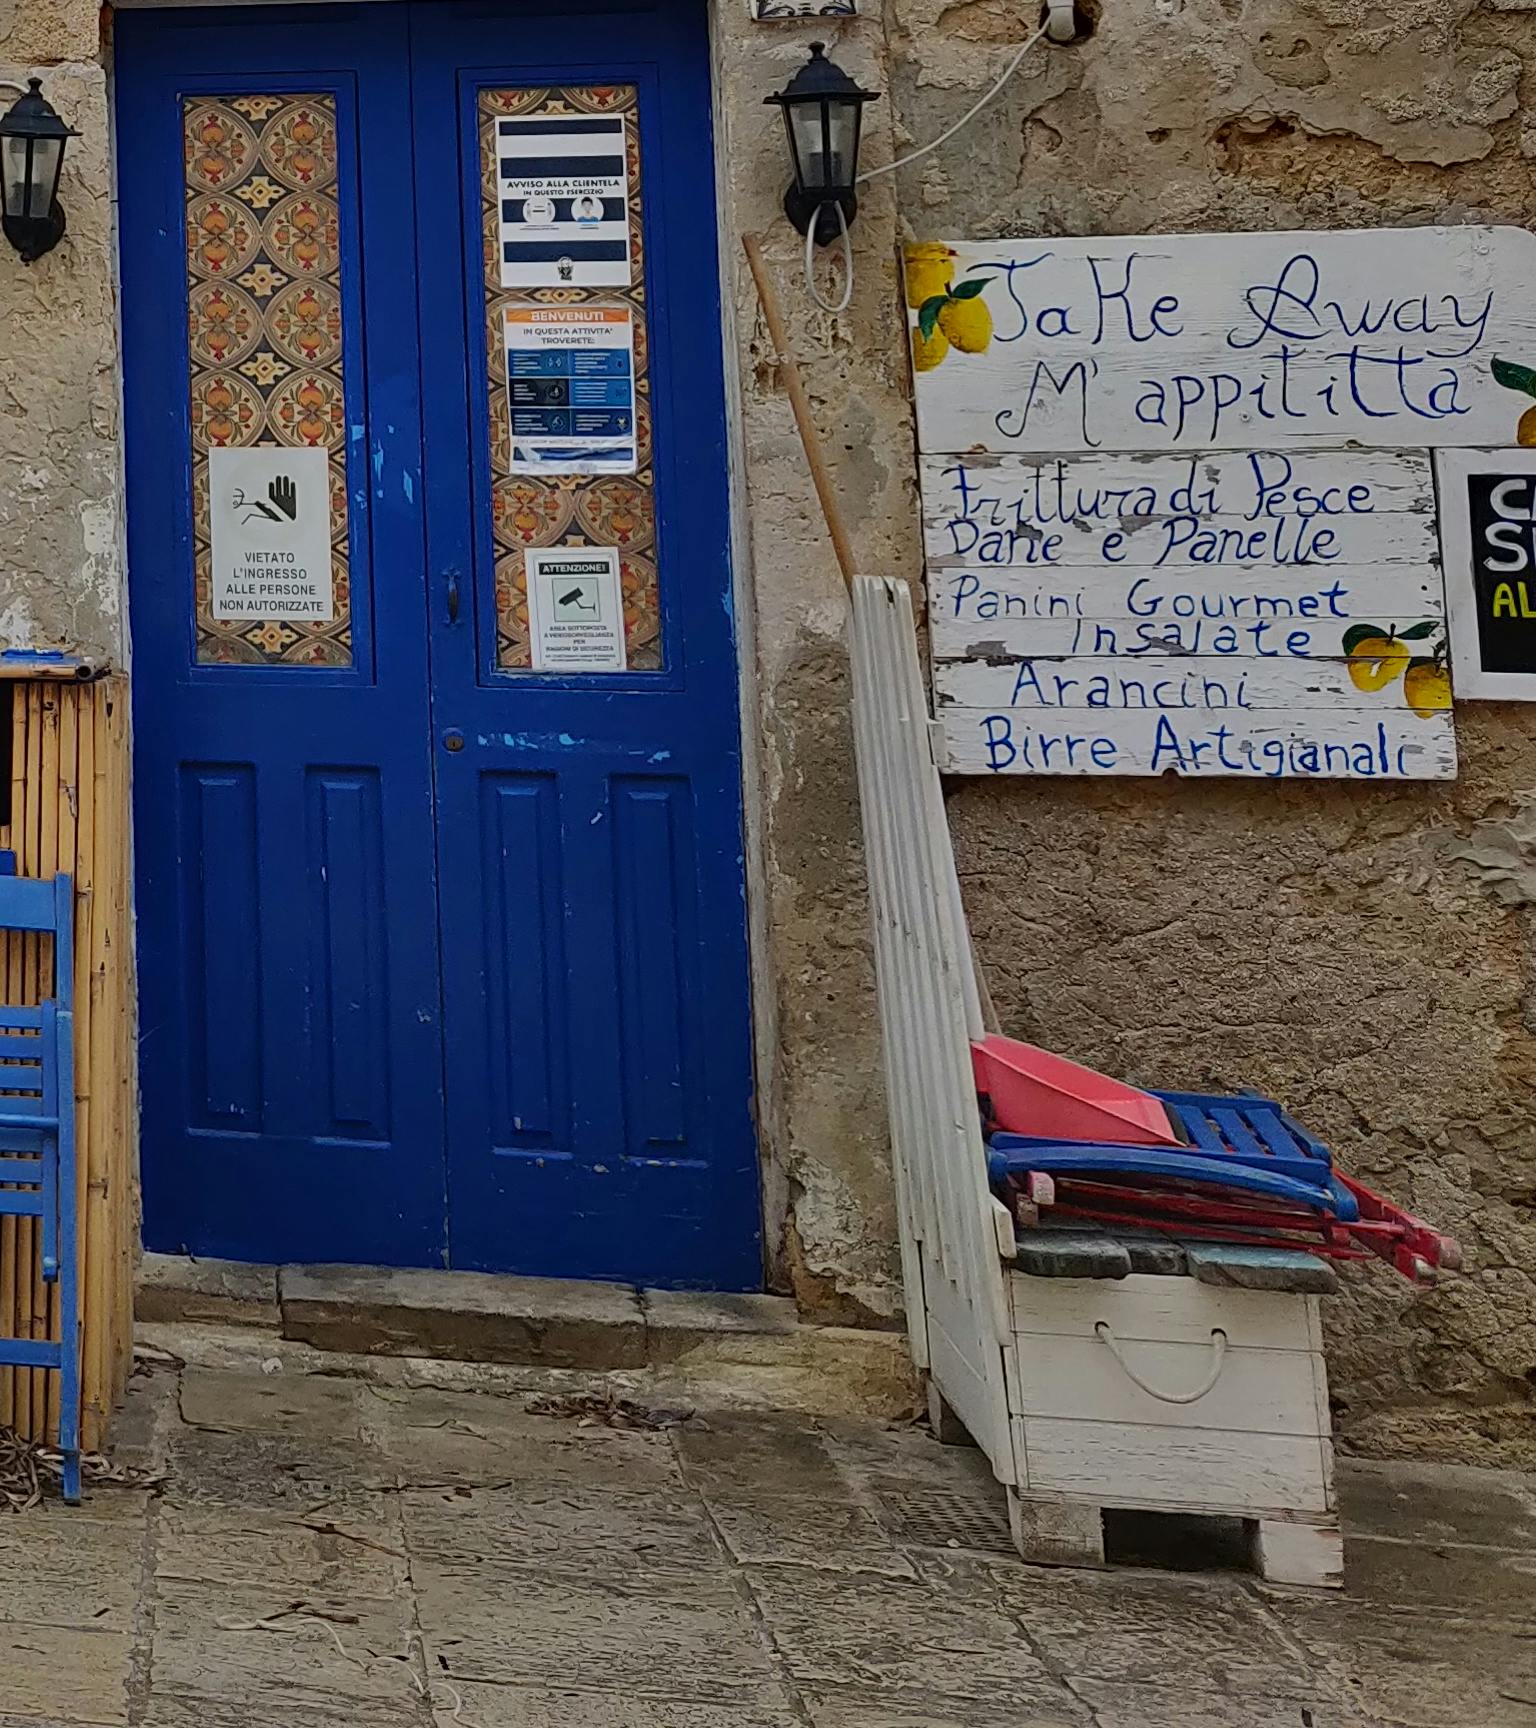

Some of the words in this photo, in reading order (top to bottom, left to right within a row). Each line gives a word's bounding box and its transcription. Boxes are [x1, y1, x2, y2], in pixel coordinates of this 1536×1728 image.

[506, 180, 544, 189] AVVISO
[546, 179, 570, 188] ALLA
[572, 178, 620, 188] CLIENTELA
[530, 311, 604, 321] BENVENUTI
[534, 327, 570, 335] QUESTA
[541, 337, 596, 345] TROVERETE:
[1243, 450, 1375, 521] Pesce
[1490, 478, 1536, 521] C
[1101, 533, 1127, 562] e
[1153, 516, 1342, 566] Panelle
[1483, 522, 1536, 572] S
[244, 552, 295, 563] VIETATO
[233, 568, 307, 579] L'INGRESSO
[542, 563, 606, 573] ATTENZIONE!
[226, 584, 256, 594] ALLE
[260, 584, 316, 595] PERSONE
[948, 574, 1086, 618] Panini
[1128, 578, 1350, 618] Gourmet
[219, 600, 244, 611] NON
[247, 600, 324, 612] AUTORIZZATE
[1070, 618, 1312, 656] Insalate
[1010, 660, 1253, 709] Arancini
[979, 714, 1119, 771] Birre
[1150, 714, 1410, 776] Artigianali
